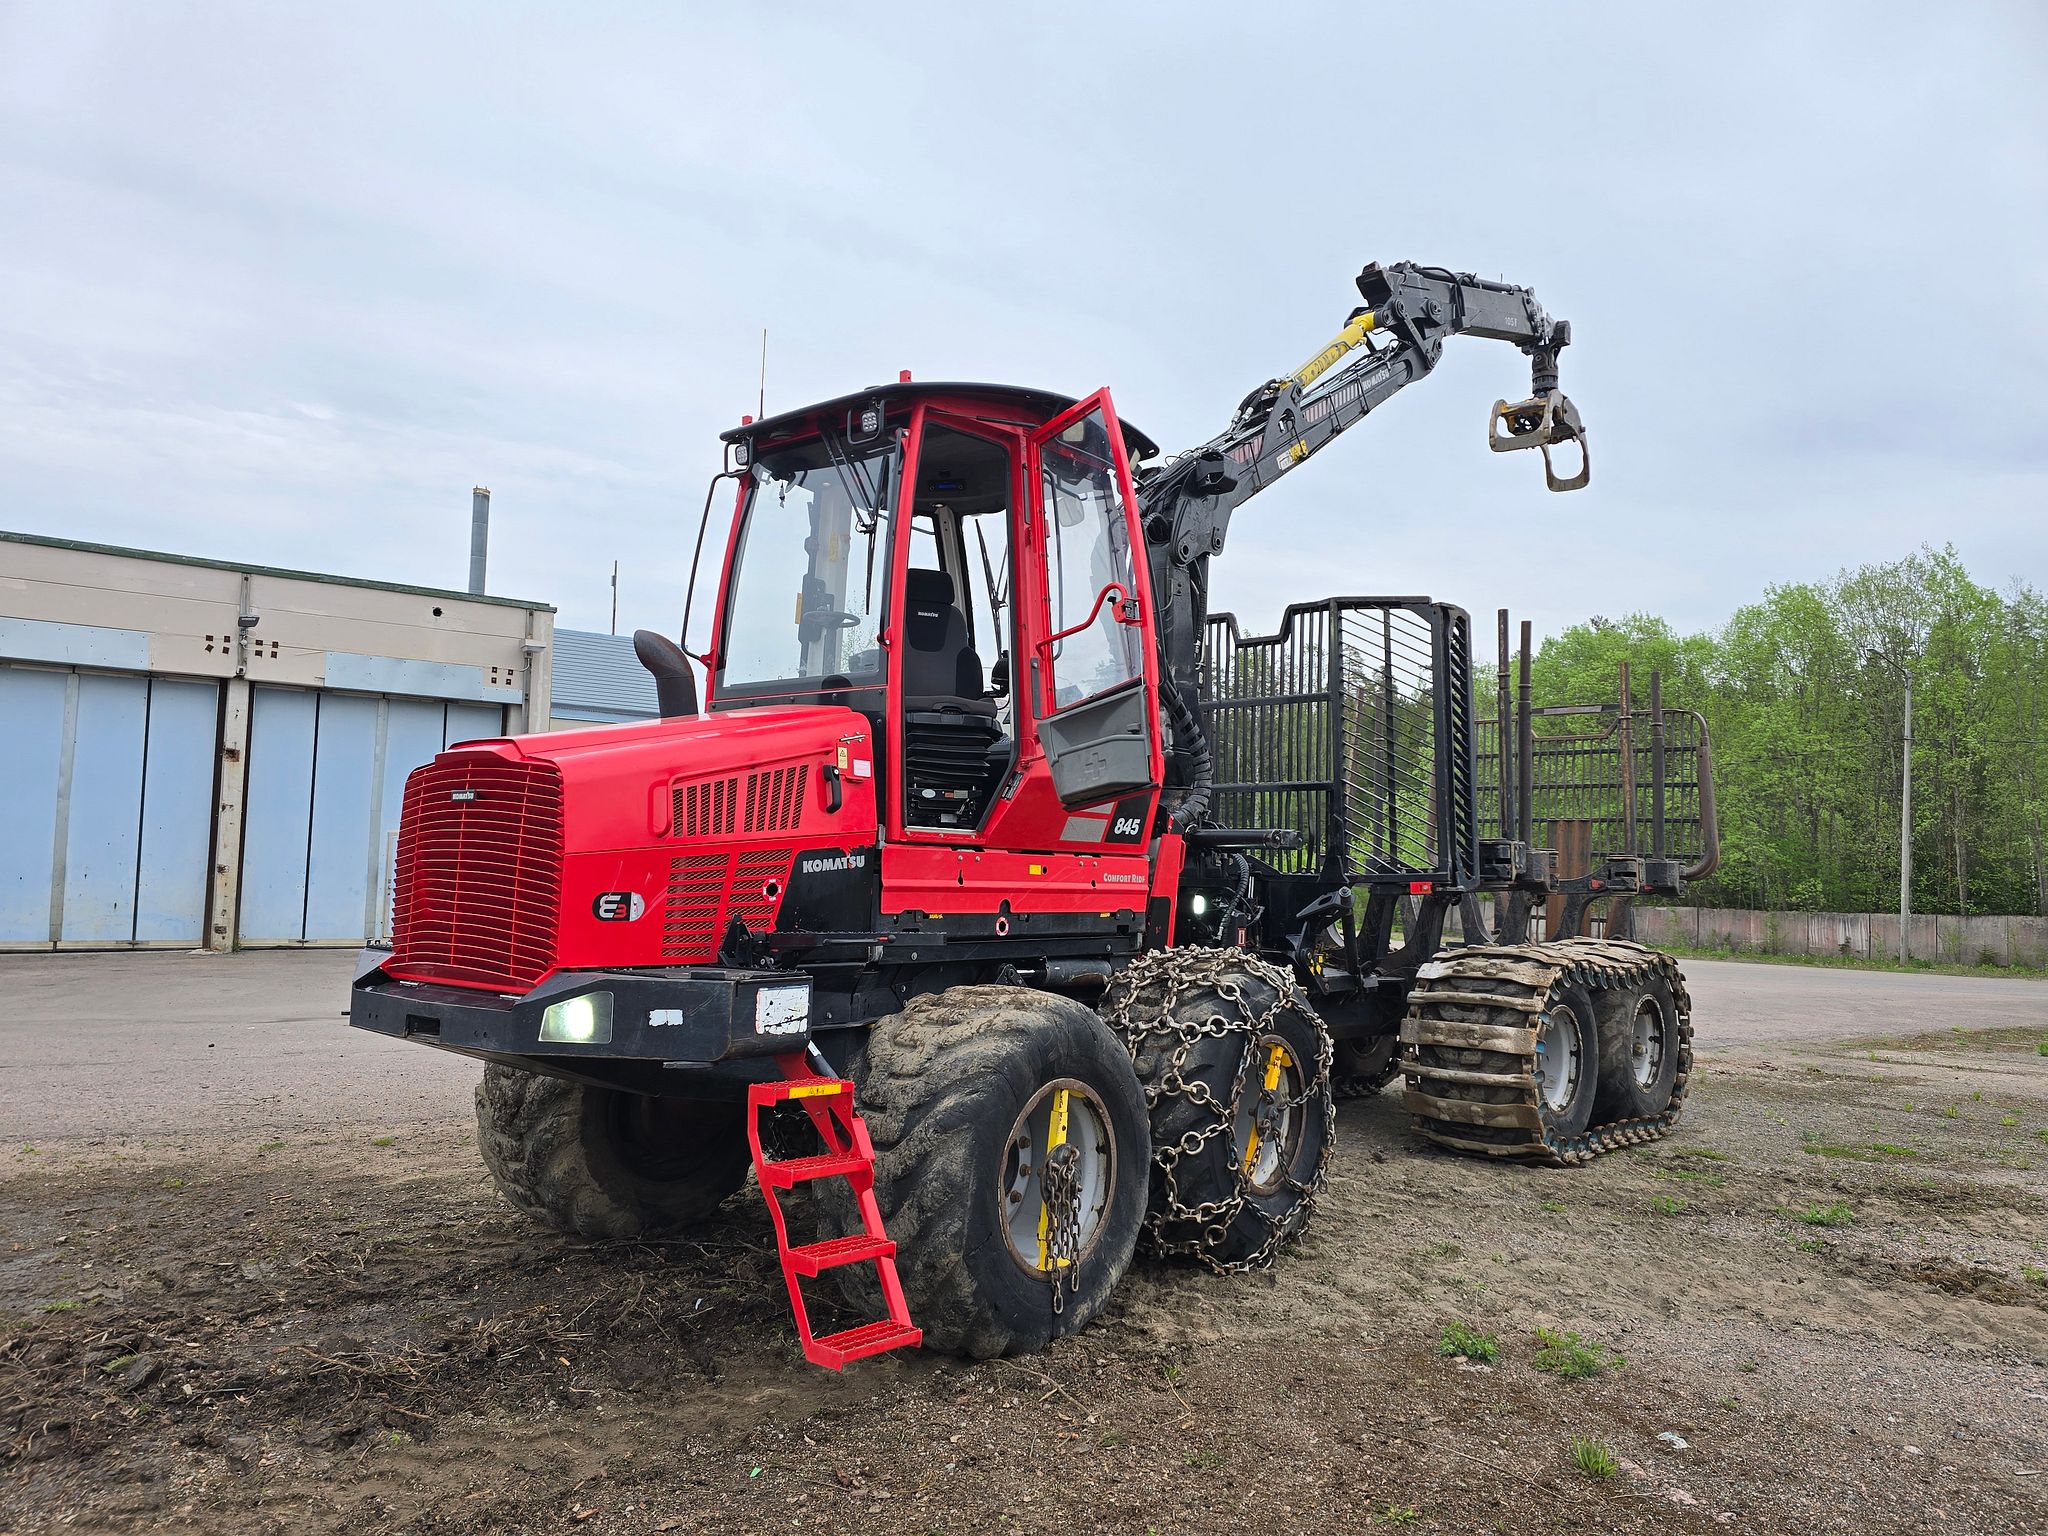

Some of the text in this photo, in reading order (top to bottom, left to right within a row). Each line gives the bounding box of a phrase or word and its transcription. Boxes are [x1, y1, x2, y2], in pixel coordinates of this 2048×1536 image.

[453, 792, 474, 800] KOMATSU
[1114, 817, 1141, 836] 845
[802, 853, 866, 874] KOMATSU
